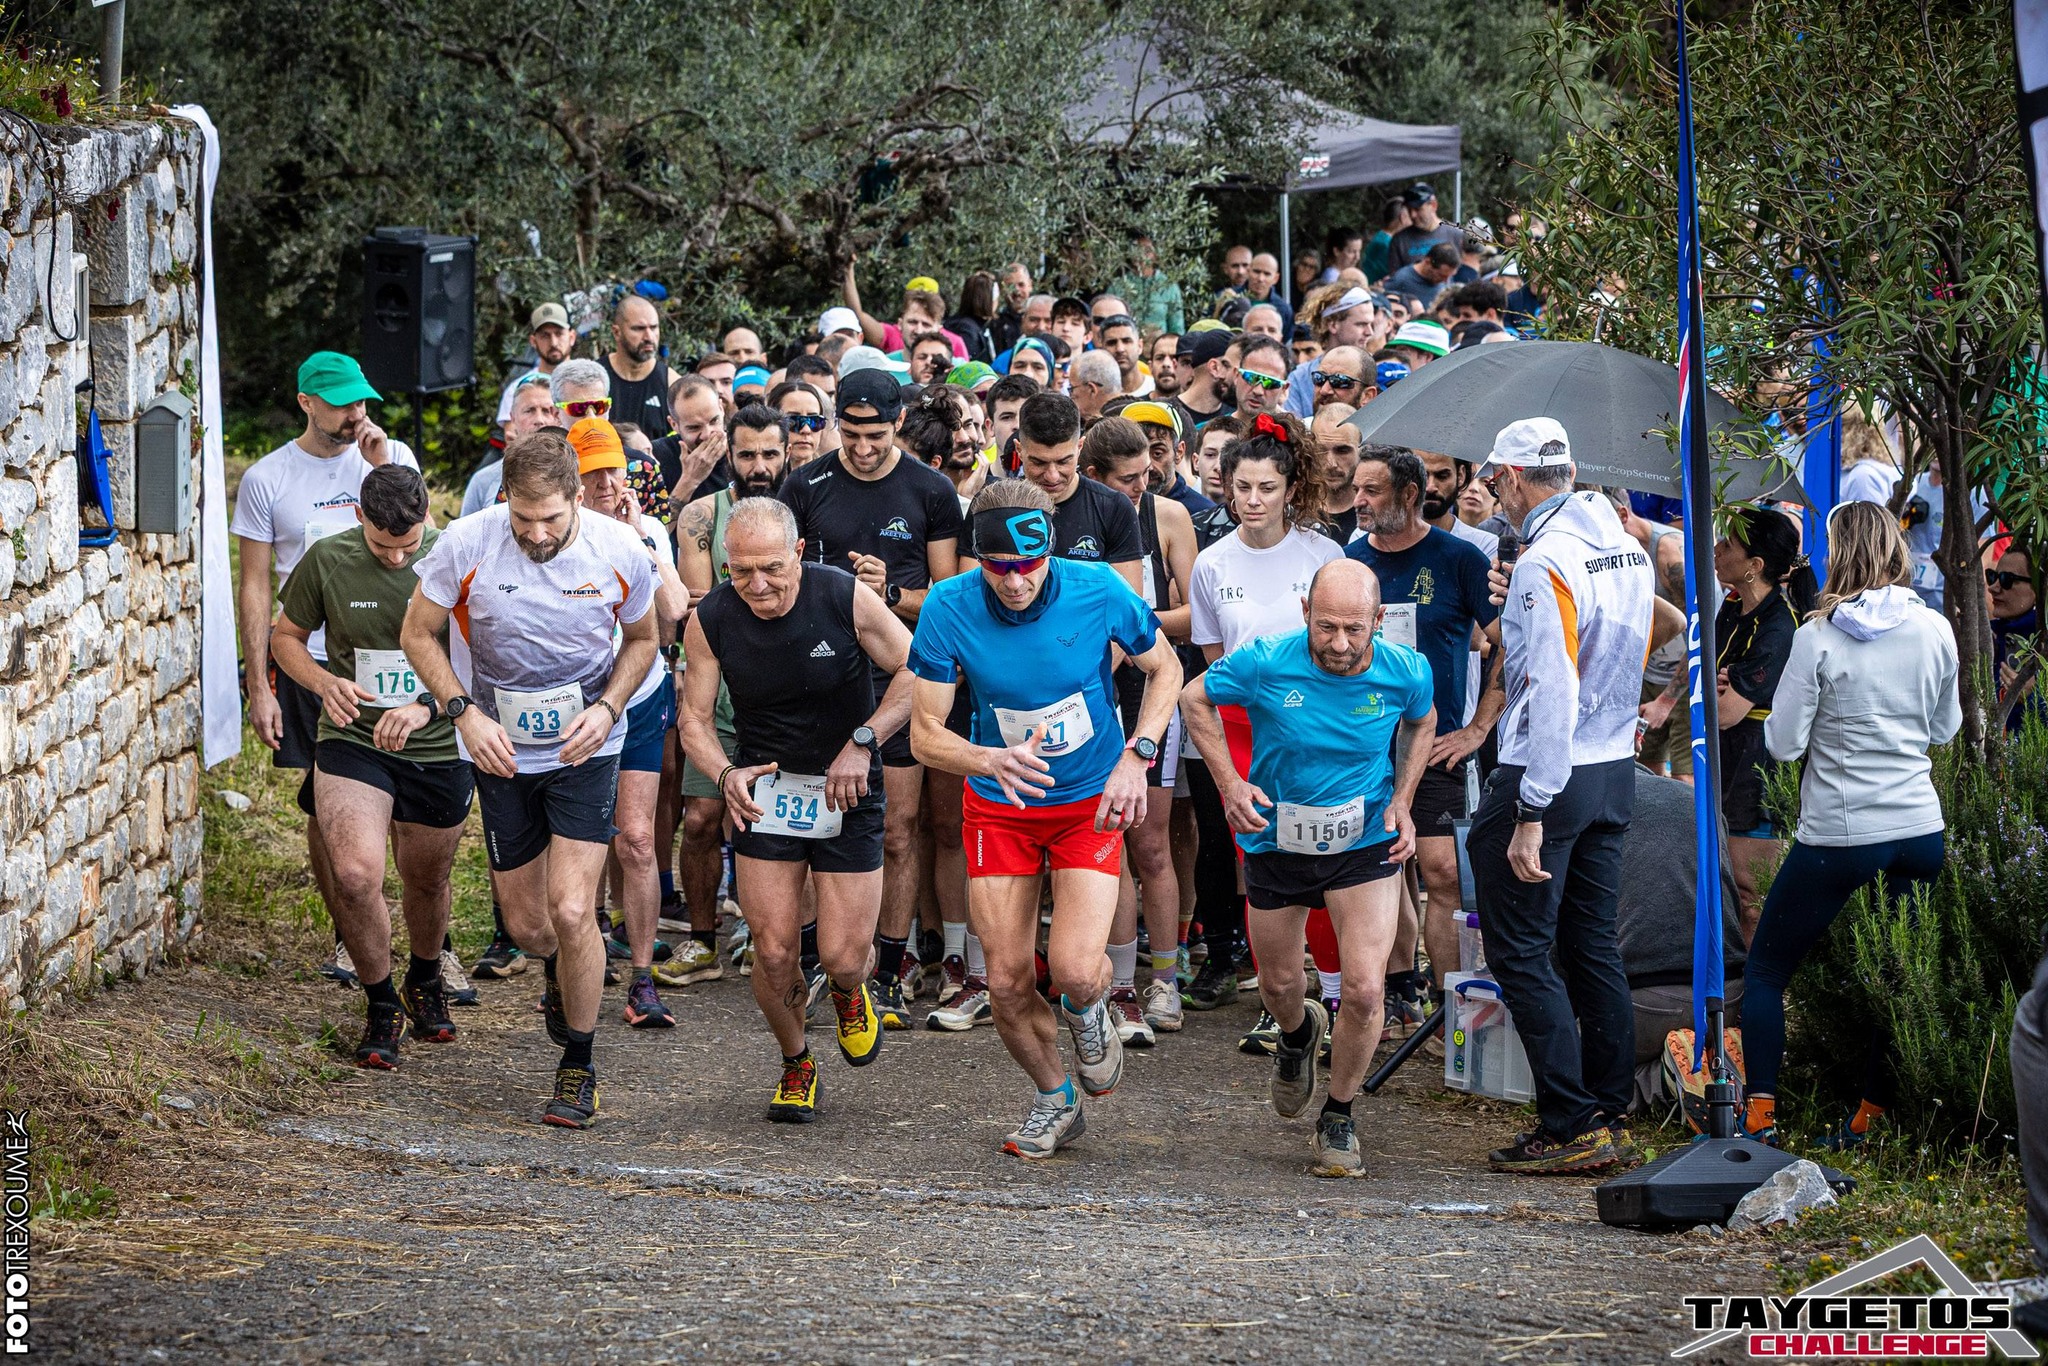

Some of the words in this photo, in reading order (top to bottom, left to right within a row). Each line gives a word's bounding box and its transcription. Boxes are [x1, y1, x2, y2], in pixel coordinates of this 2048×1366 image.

[1578, 460, 1606, 472] Bayer
[1608, 465, 1670, 482] CropScience
[313, 498, 359, 508] TAYGETOS
[1626, 552, 1648, 566] TEAM
[1521, 592, 1536, 612] 15
[375, 671, 415, 693] 176
[517, 710, 560, 731] 433
[775, 794, 818, 821] 534
[1294, 820, 1349, 842] 1156
